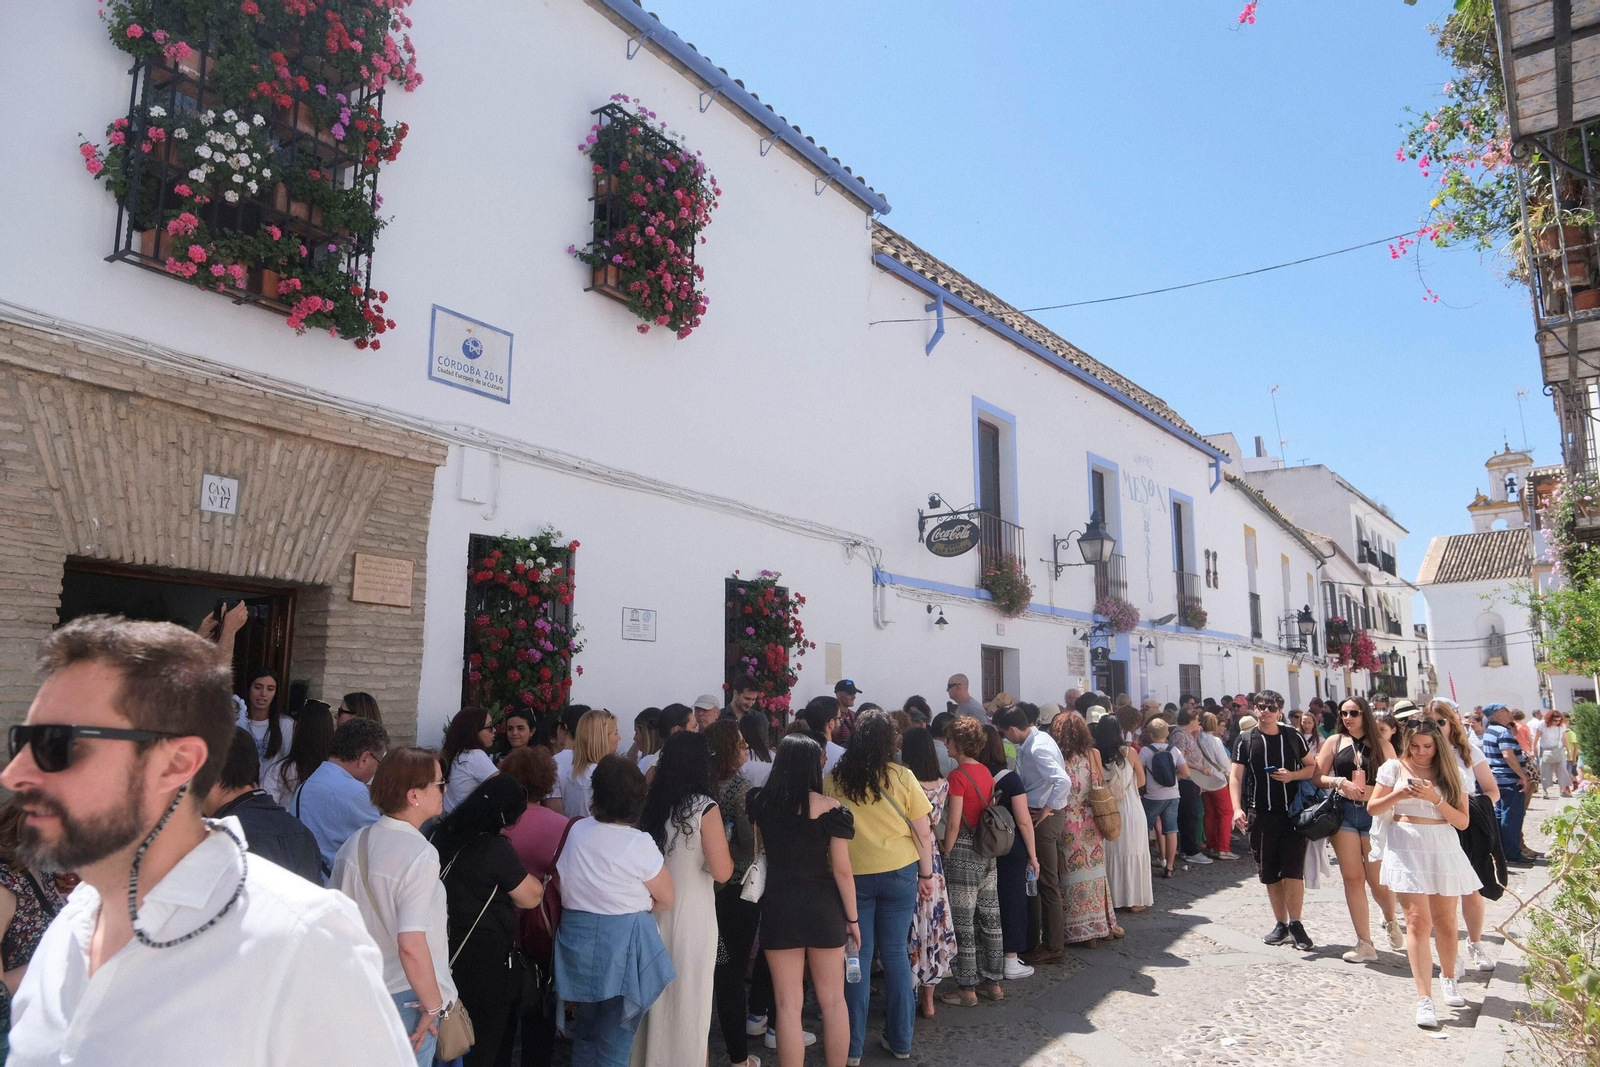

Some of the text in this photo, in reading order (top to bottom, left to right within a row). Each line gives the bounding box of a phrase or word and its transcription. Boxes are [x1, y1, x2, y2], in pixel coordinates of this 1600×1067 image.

[437, 355, 504, 385] CÓRDOBA 2016
[437, 366, 455, 377] Ciudad
[455, 371, 475, 383] Europea
[487, 381, 504, 392] Cultura
[208, 481, 231, 497] CASA
[219, 495, 231, 510] 17
[1143, 519, 1154, 604] BASILIO
